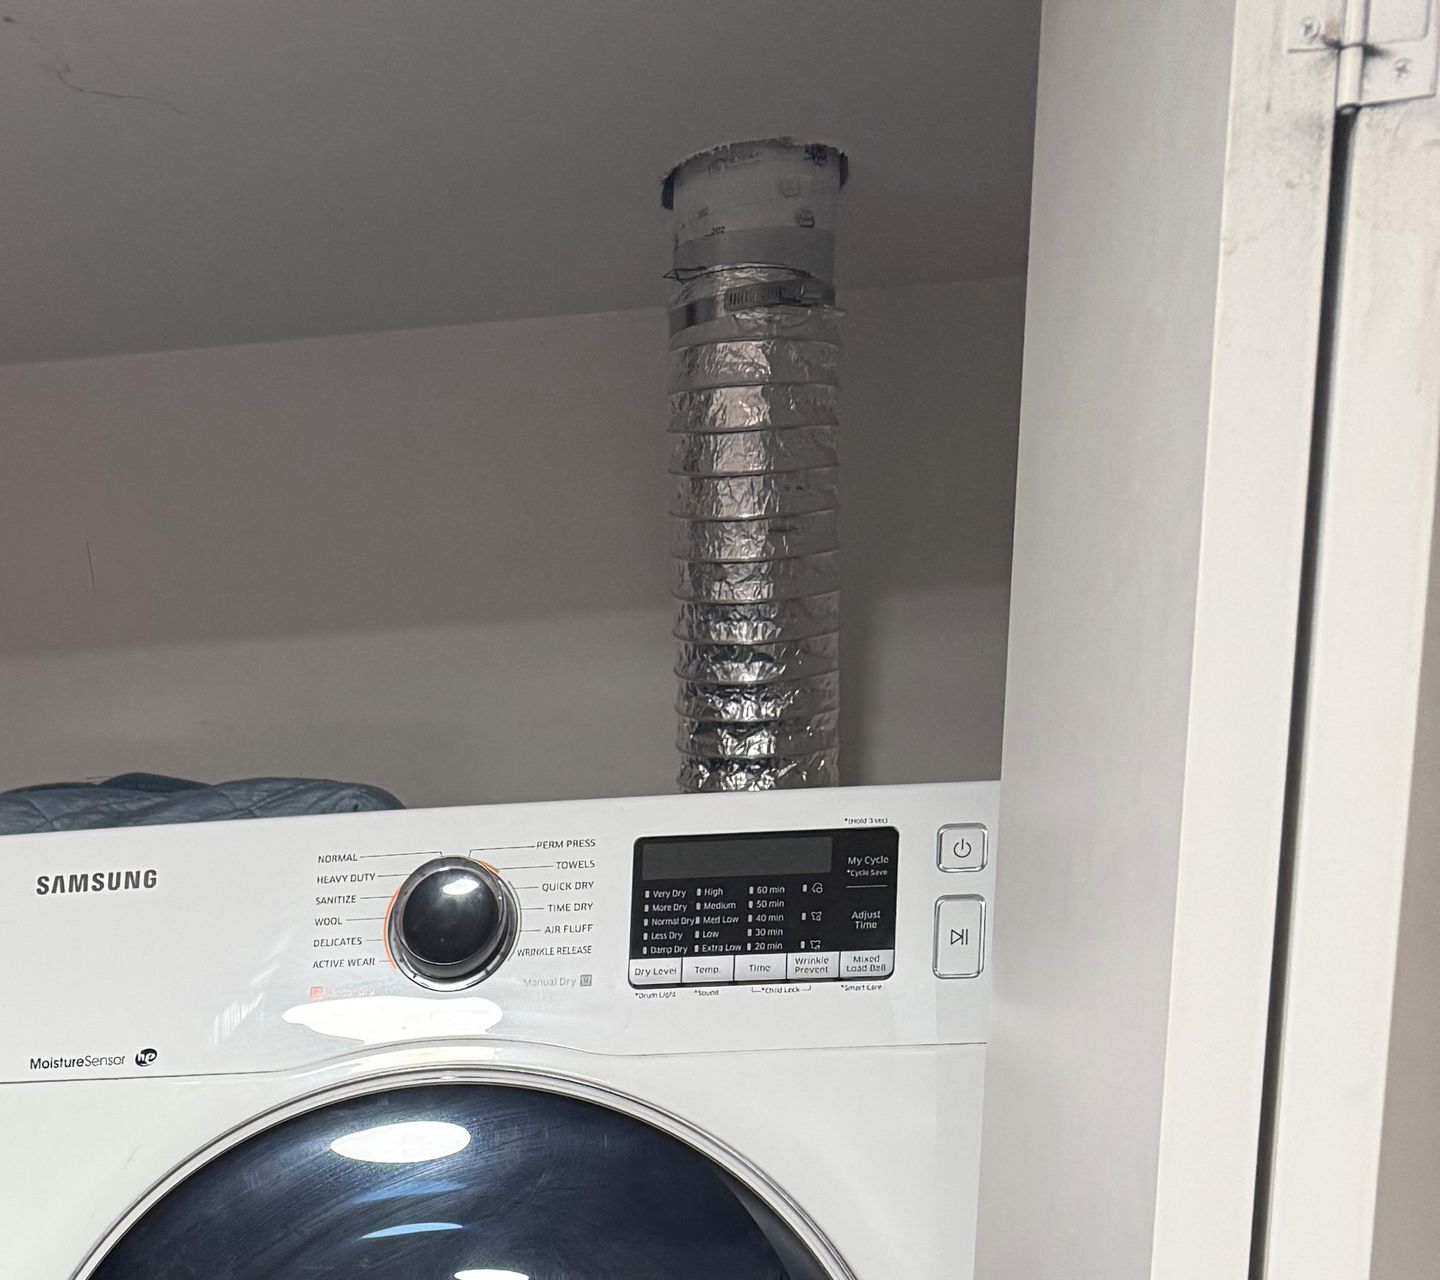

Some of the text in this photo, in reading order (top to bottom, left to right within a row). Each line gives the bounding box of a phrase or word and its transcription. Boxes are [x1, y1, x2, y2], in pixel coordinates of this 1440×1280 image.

[536, 839, 596, 849] PERM PRESS
[318, 854, 358, 863] NORMAL
[847, 855, 889, 865] My Cycle
[556, 860, 596, 869] TOWELS
[871, 868, 888, 876] Save
[36, 869, 157, 895] SAMSUNG
[317, 873, 376, 884] HEAVY DUTY
[542, 881, 594, 892] QUICK DRY
[756, 886, 785, 894] 60 min
[653, 889, 686, 899] Very Dry
[704, 887, 724, 897] High
[316, 895, 357, 905] SANITIZE
[756, 900, 785, 908] 50 min
[548, 903, 593, 912] TIME DRY
[652, 903, 687, 912] More Dry
[704, 902, 736, 910] Medium
[755, 914, 784, 922] 40 min
[851, 910, 881, 920] Adjust
[315, 917, 343, 926] WOOL
[651, 917, 695, 926] Normal Dry
[703, 916, 739, 924] Med Low
[855, 920, 878, 929] Time
[544, 924, 593, 934] AIR FLUFF
[755, 928, 783, 936] 30 min
[651, 931, 683, 940] Less Dry
[702, 930, 719, 938] Low
[313, 937, 362, 947] DELICATES
[754, 942, 783, 951] 20 min
[517, 946, 592, 956] WRINKLE RELEASE
[651, 945, 688, 955] Damp Dry
[702, 943, 742, 952] Extra Low
[313, 958, 376, 968] ACTIVE WEAR
[794, 956, 829, 965] Wrinkle
[853, 955, 880, 963] Mixed
[634, 967, 677, 977] Dry Level
[749, 963, 771, 972] Time
[794, 966, 829, 974] Prevent
[846, 964, 869, 972] Load
[560, 977, 576, 987] Dry
[30, 1055, 126, 1070] MoistureSensor
